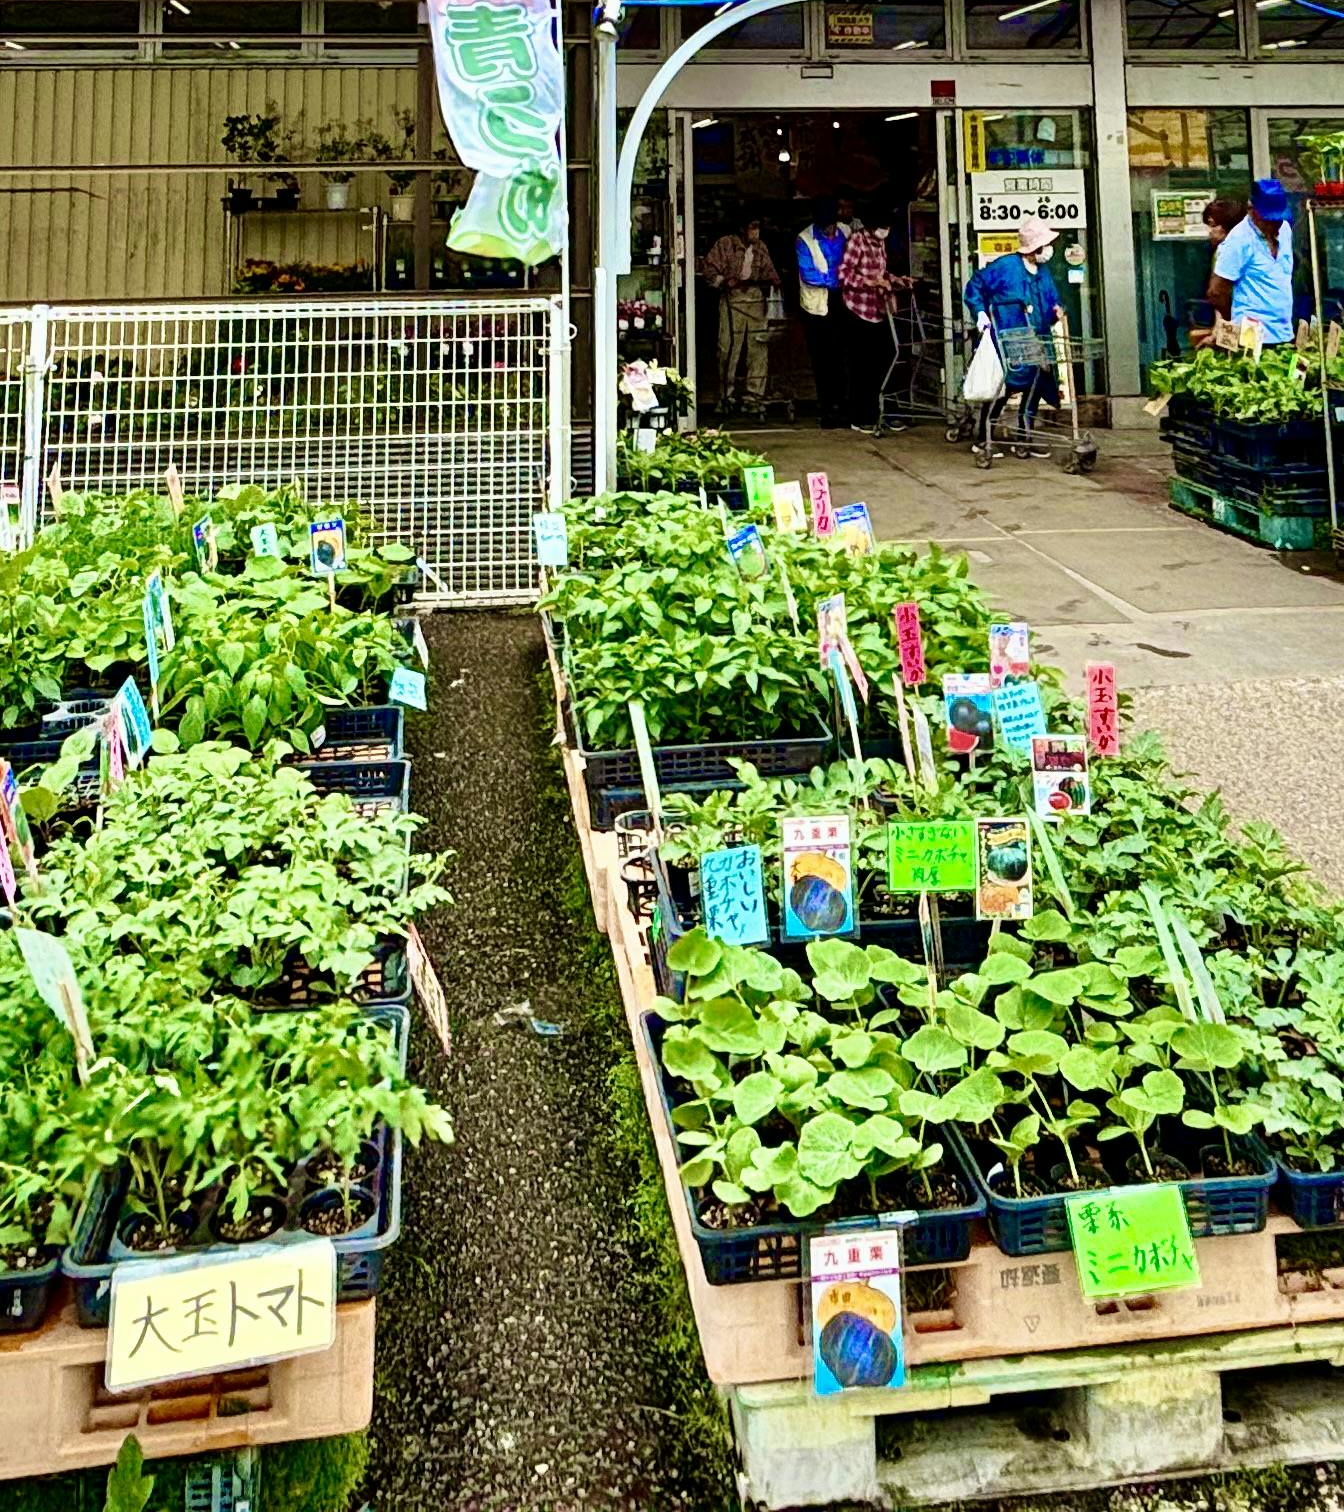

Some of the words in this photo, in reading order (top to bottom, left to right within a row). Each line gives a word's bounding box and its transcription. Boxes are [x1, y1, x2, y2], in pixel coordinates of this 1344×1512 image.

[899, 606, 925, 682] 小玉すいか
[1092, 668, 1116, 751] 小玉すいか
[735, 850, 758, 913] おいしい
[895, 844, 968, 864] ミニカボチャ
[824, 1245, 884, 1266] 九重栗
[1087, 1235, 1194, 1285] ミニカボチャ
[128, 1268, 325, 1359] 大玉トマト
